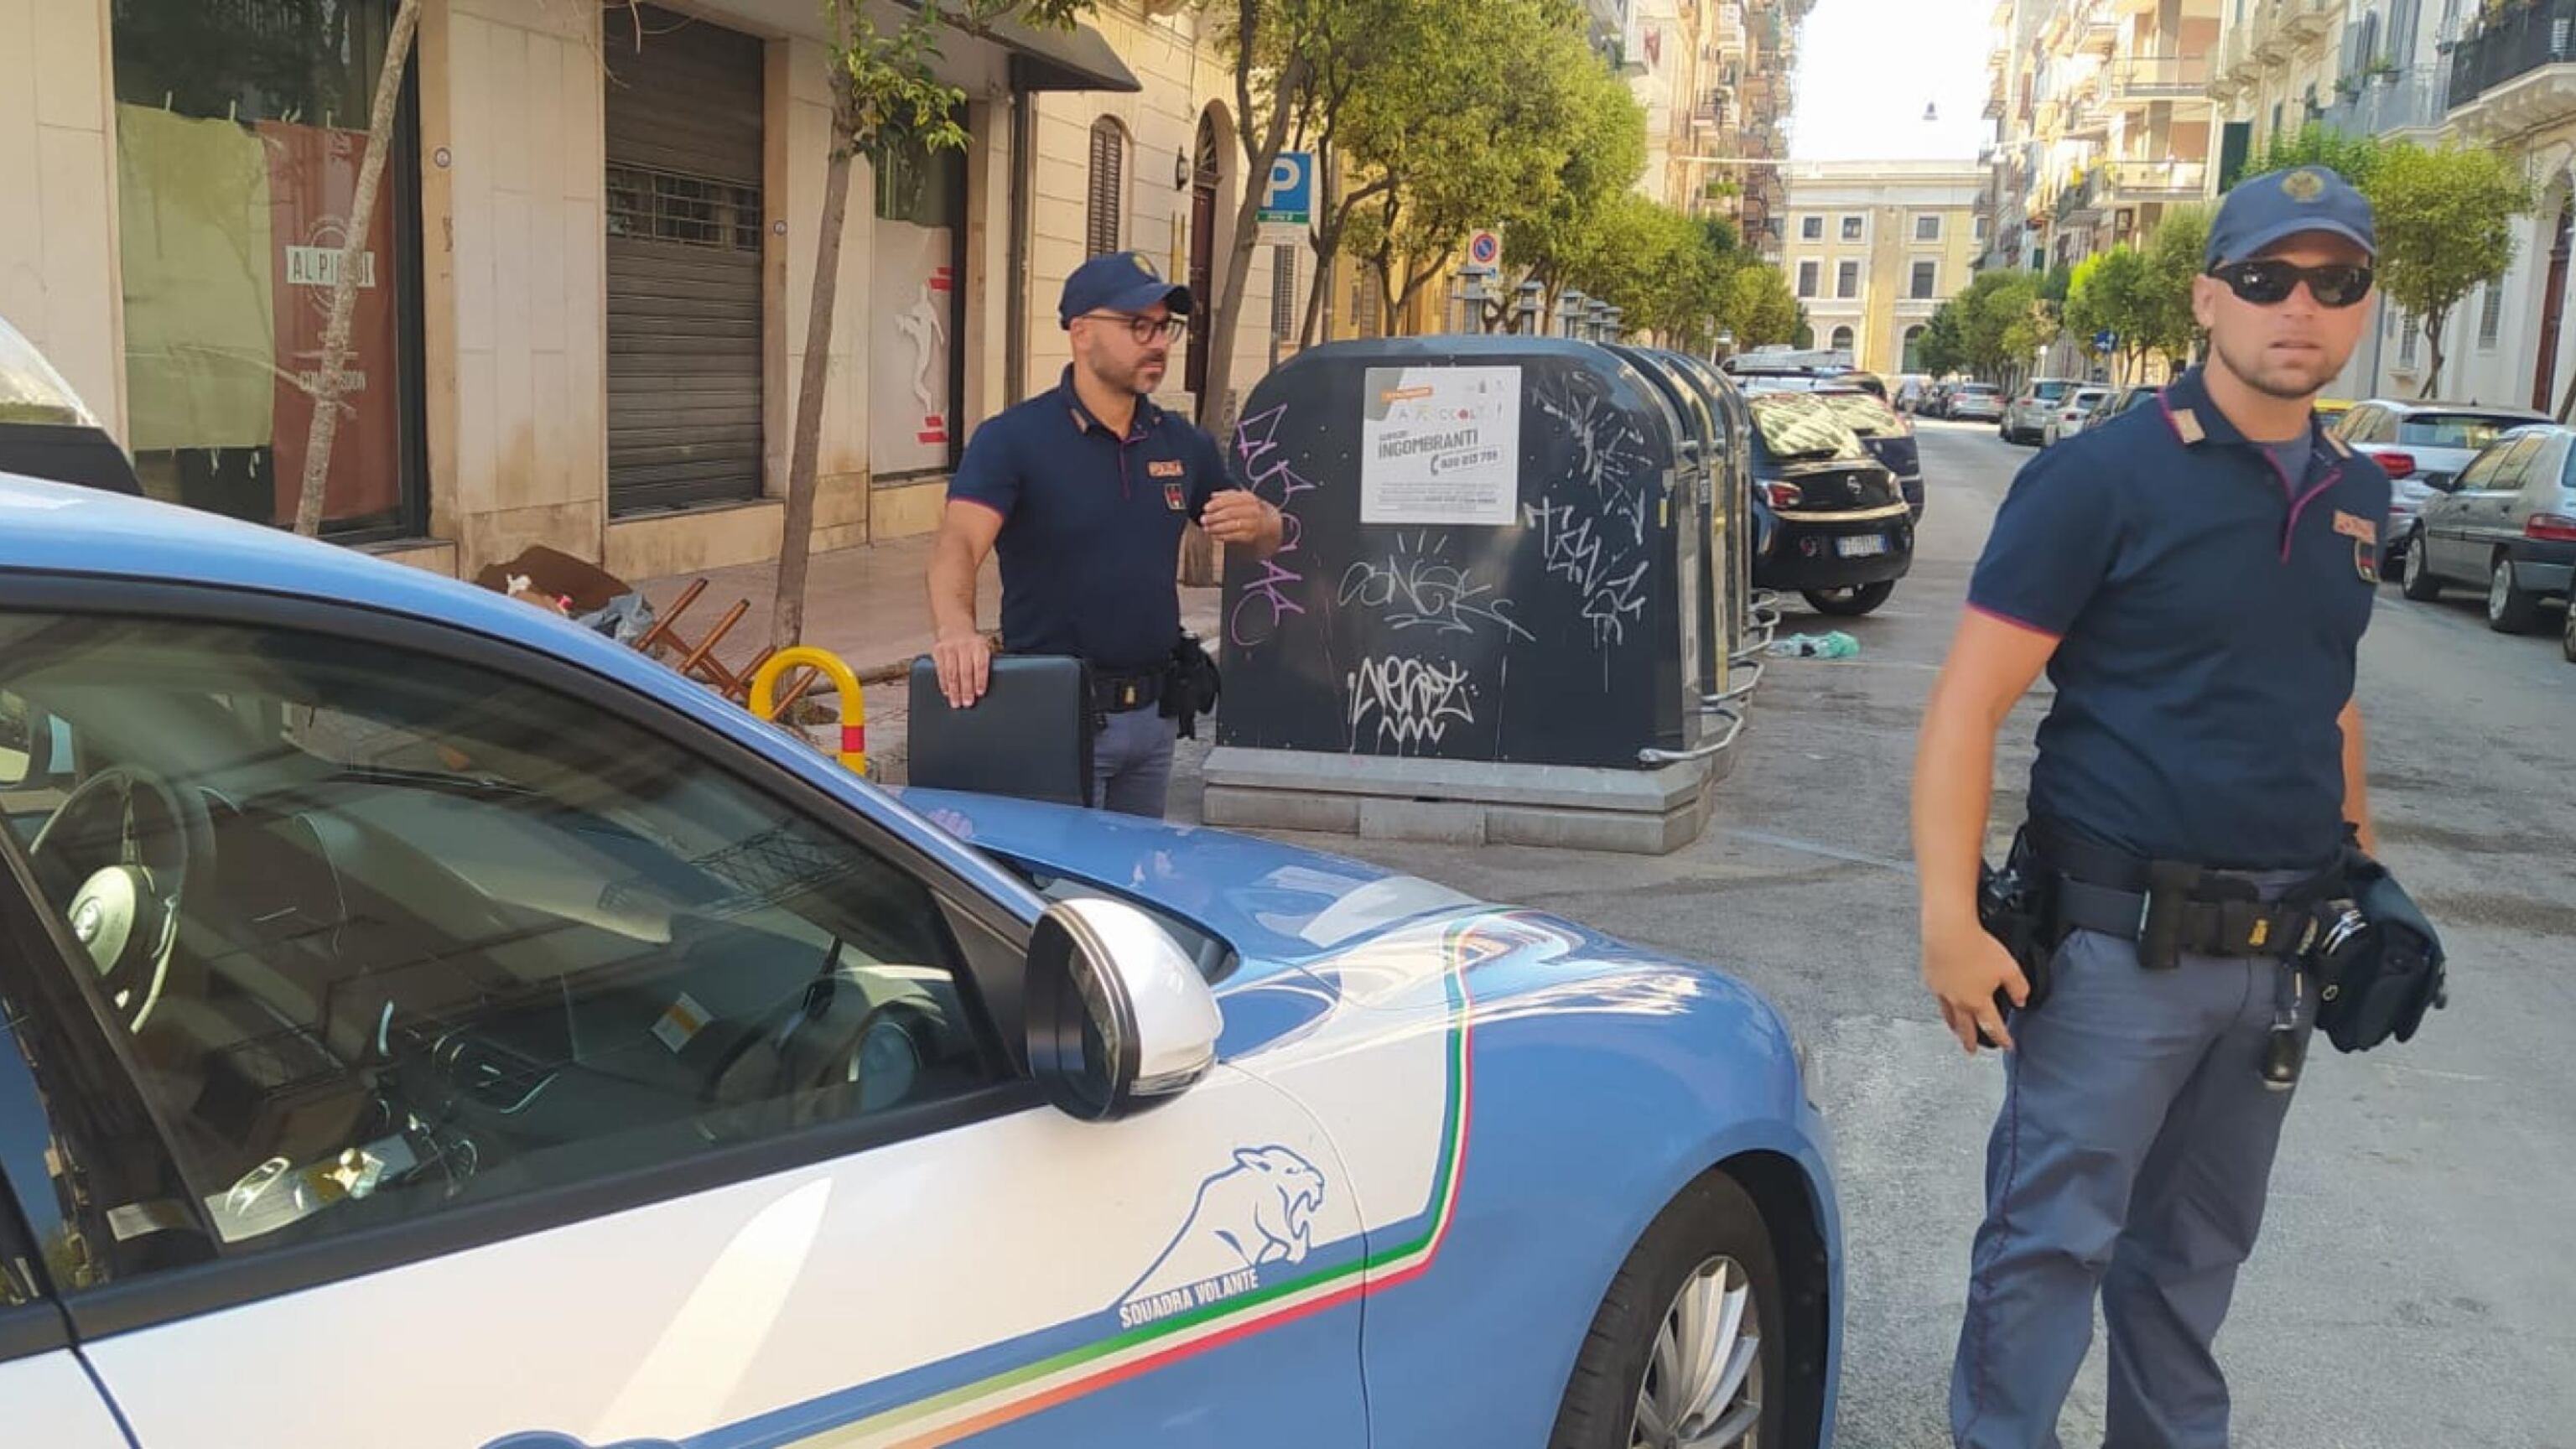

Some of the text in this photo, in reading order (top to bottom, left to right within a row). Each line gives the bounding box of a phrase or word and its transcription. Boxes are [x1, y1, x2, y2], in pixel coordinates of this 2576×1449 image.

[1263, 158, 1300, 207] P
[1379, 429, 1478, 460] INGOMBRANTI
[1119, 1268, 1259, 1329] SQUADRA VOLANTE
